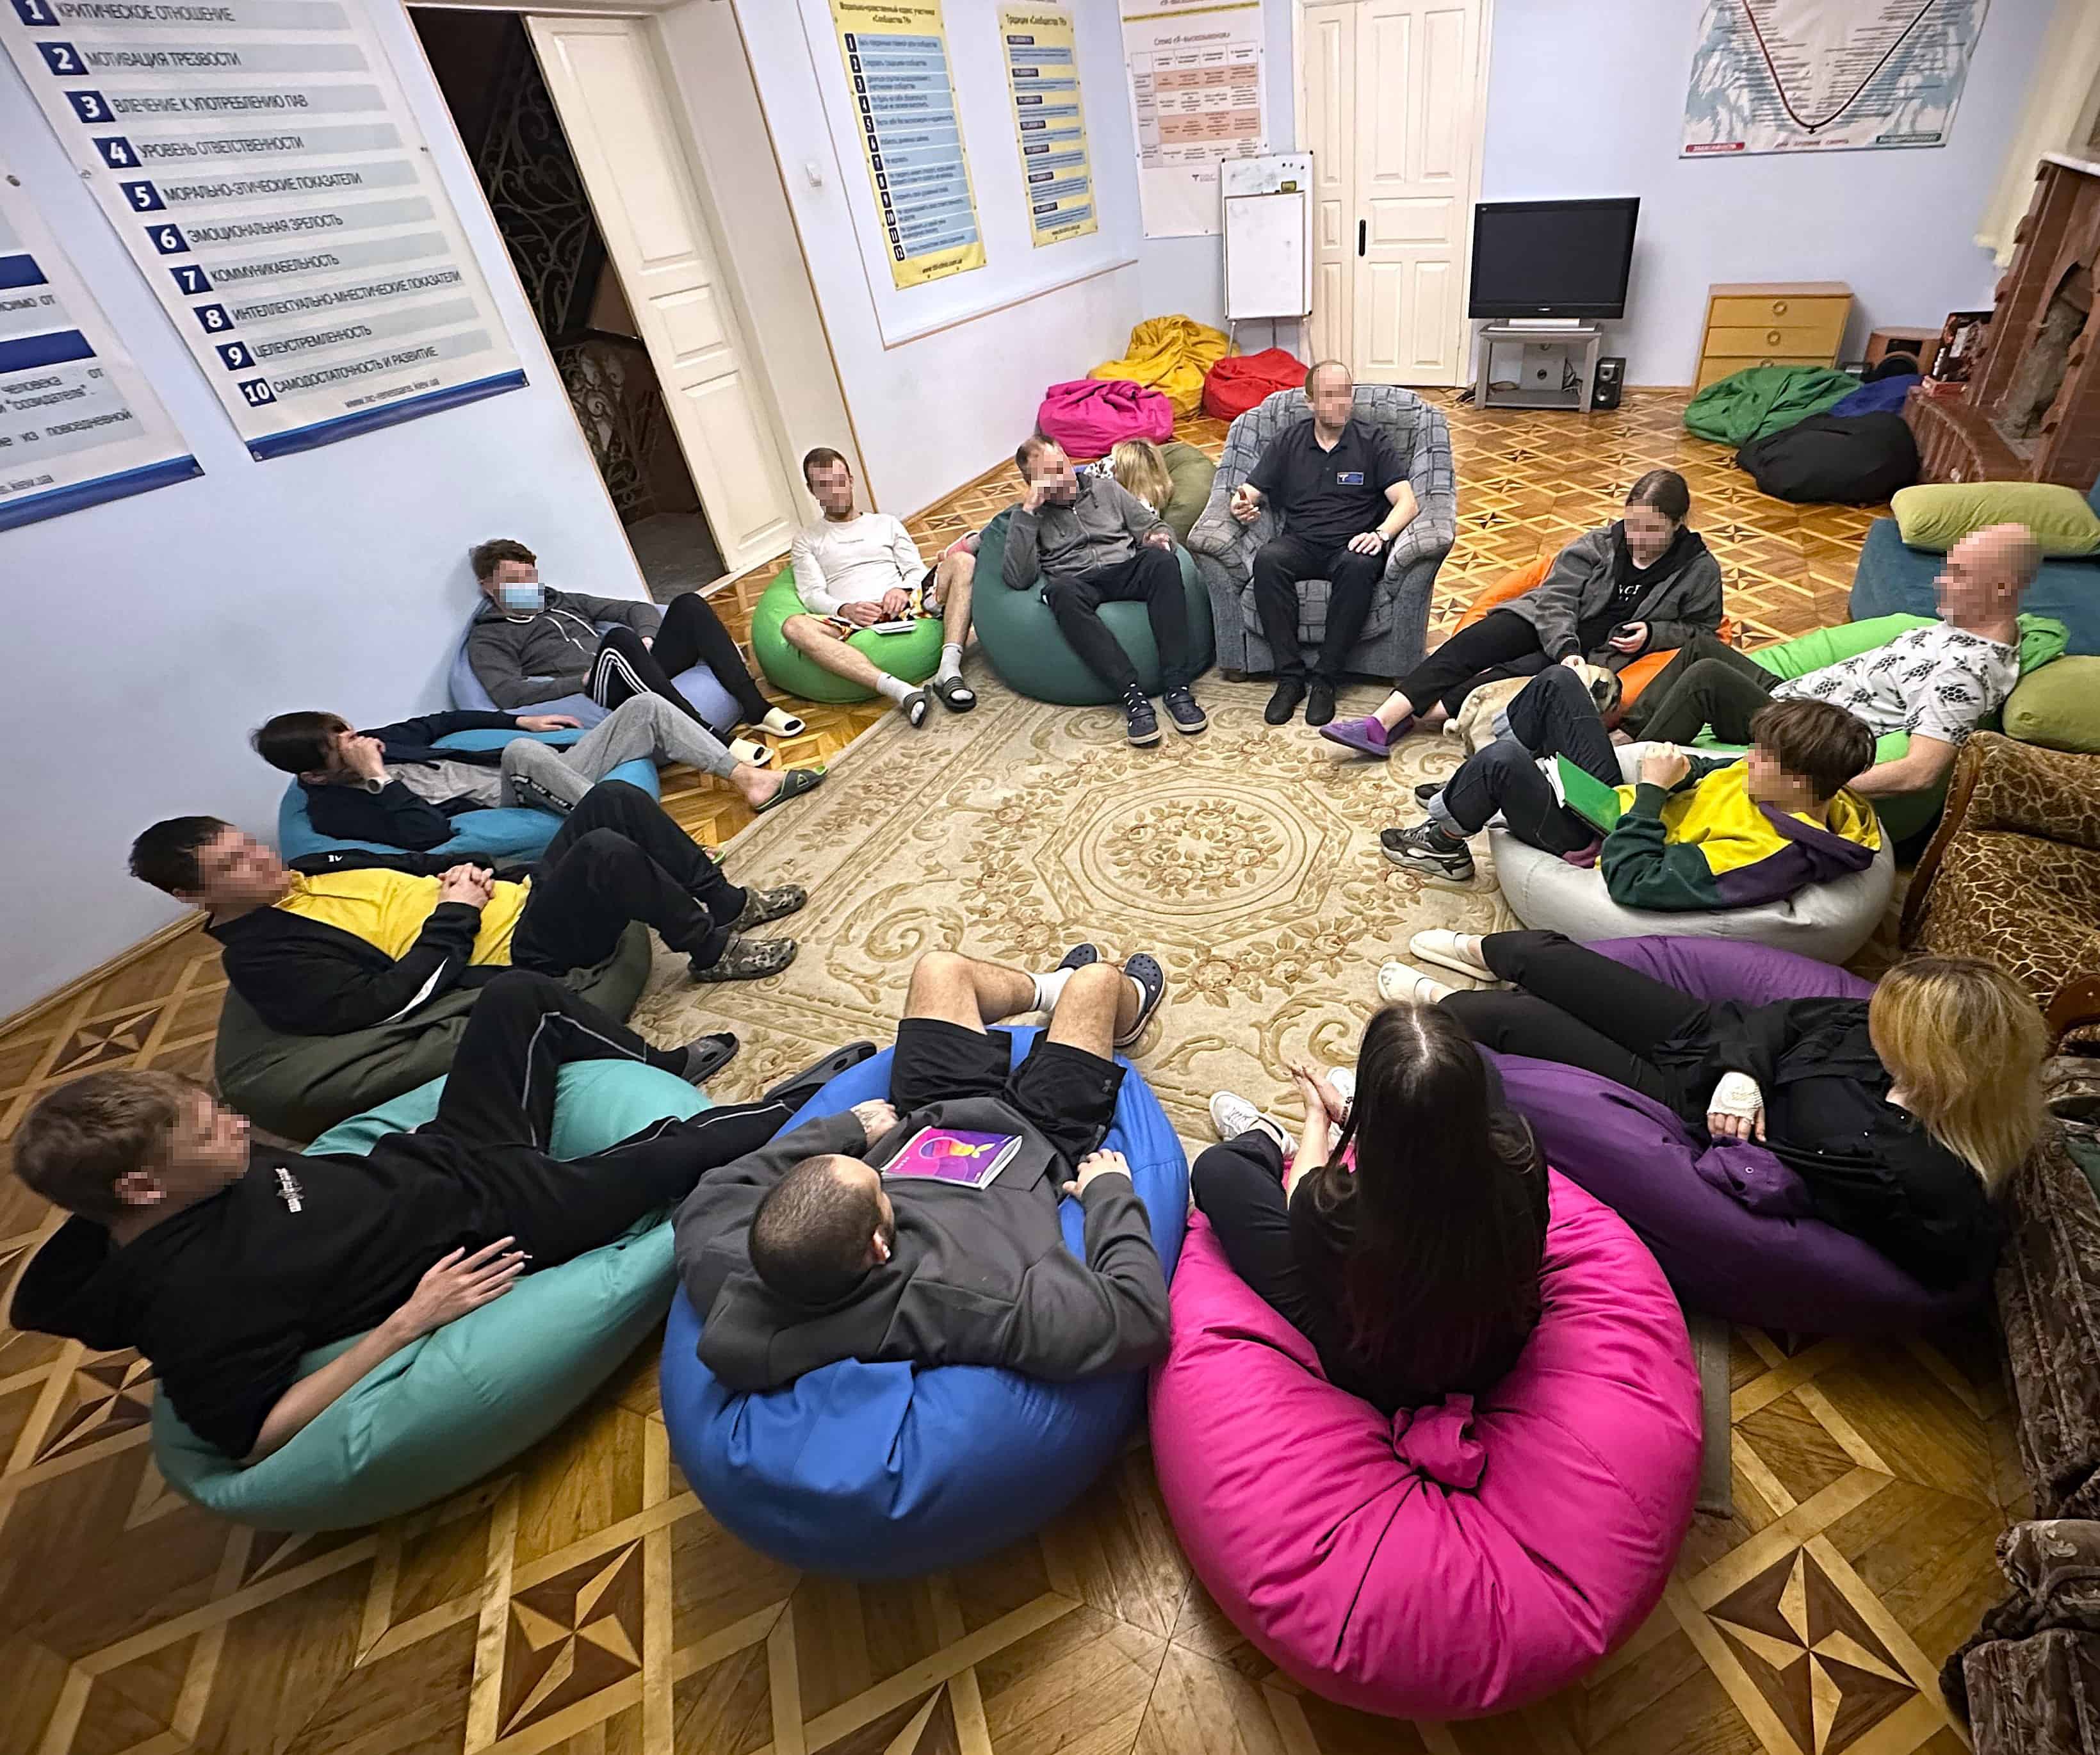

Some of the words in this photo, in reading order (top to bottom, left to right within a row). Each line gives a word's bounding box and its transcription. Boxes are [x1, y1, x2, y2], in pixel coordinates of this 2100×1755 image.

[26, 0, 44, 20] 1
[57, 3, 155, 20] КРИТИЧЕСКОЕ
[157, 5, 236, 22] ОТНОШЕНИЕ
[52, 47, 73, 70] 2
[85, 52, 167, 68] МОТИВАЦИЯ
[168, 52, 241, 66] ТРЕЗВОСТИ
[79, 96, 101, 118] 3
[111, 97, 181, 113] ВЛЕЧЕНИЕ
[181, 97, 192, 112] К
[190, 95, 285, 112] УПОТРЕБЛЕНИЮ
[284, 94, 309, 108] ПАВ
[110, 142, 127, 164] 4
[136, 142, 197, 158] УРОВЕНЬ
[197, 136, 305, 155] ОТВЕТСТВЕННОСТИ
[133, 186, 151, 208] 5
[161, 180, 297, 201] МОРАЛЬНО-ЭТИЧЕСКИЕ
[296, 172, 362, 190] ПОКАЗАТЕЛИ
[160, 227, 177, 249] 6
[188, 219, 288, 243] ЭМОЦИОНАЛЬНАЯ
[291, 214, 344, 231] ЗРЕЛОСТЬ
[182, 271, 197, 290] 7
[210, 254, 339, 282] КОММУНИКАБЕЛЬНОСТЬ
[208, 309, 223, 328] 8
[231, 281, 409, 320] ИНТЕЛЛЕКТУАЛЬНО-МНЕСТИЧЕСКИЕ
[407, 270, 462, 290] ПОКАЗАТЕЛИ
[227, 347, 242, 365] 9
[252, 325, 371, 358] ЦЕЛЕУСТРЕМЛЕННОСТЬ
[245, 382, 270, 402] 10
[273, 359, 383, 393] САМОДОСТАТОЧНОСТЬ
[382, 356, 394, 369] И
[393, 347, 438, 365] РАЗВИТИЕ
